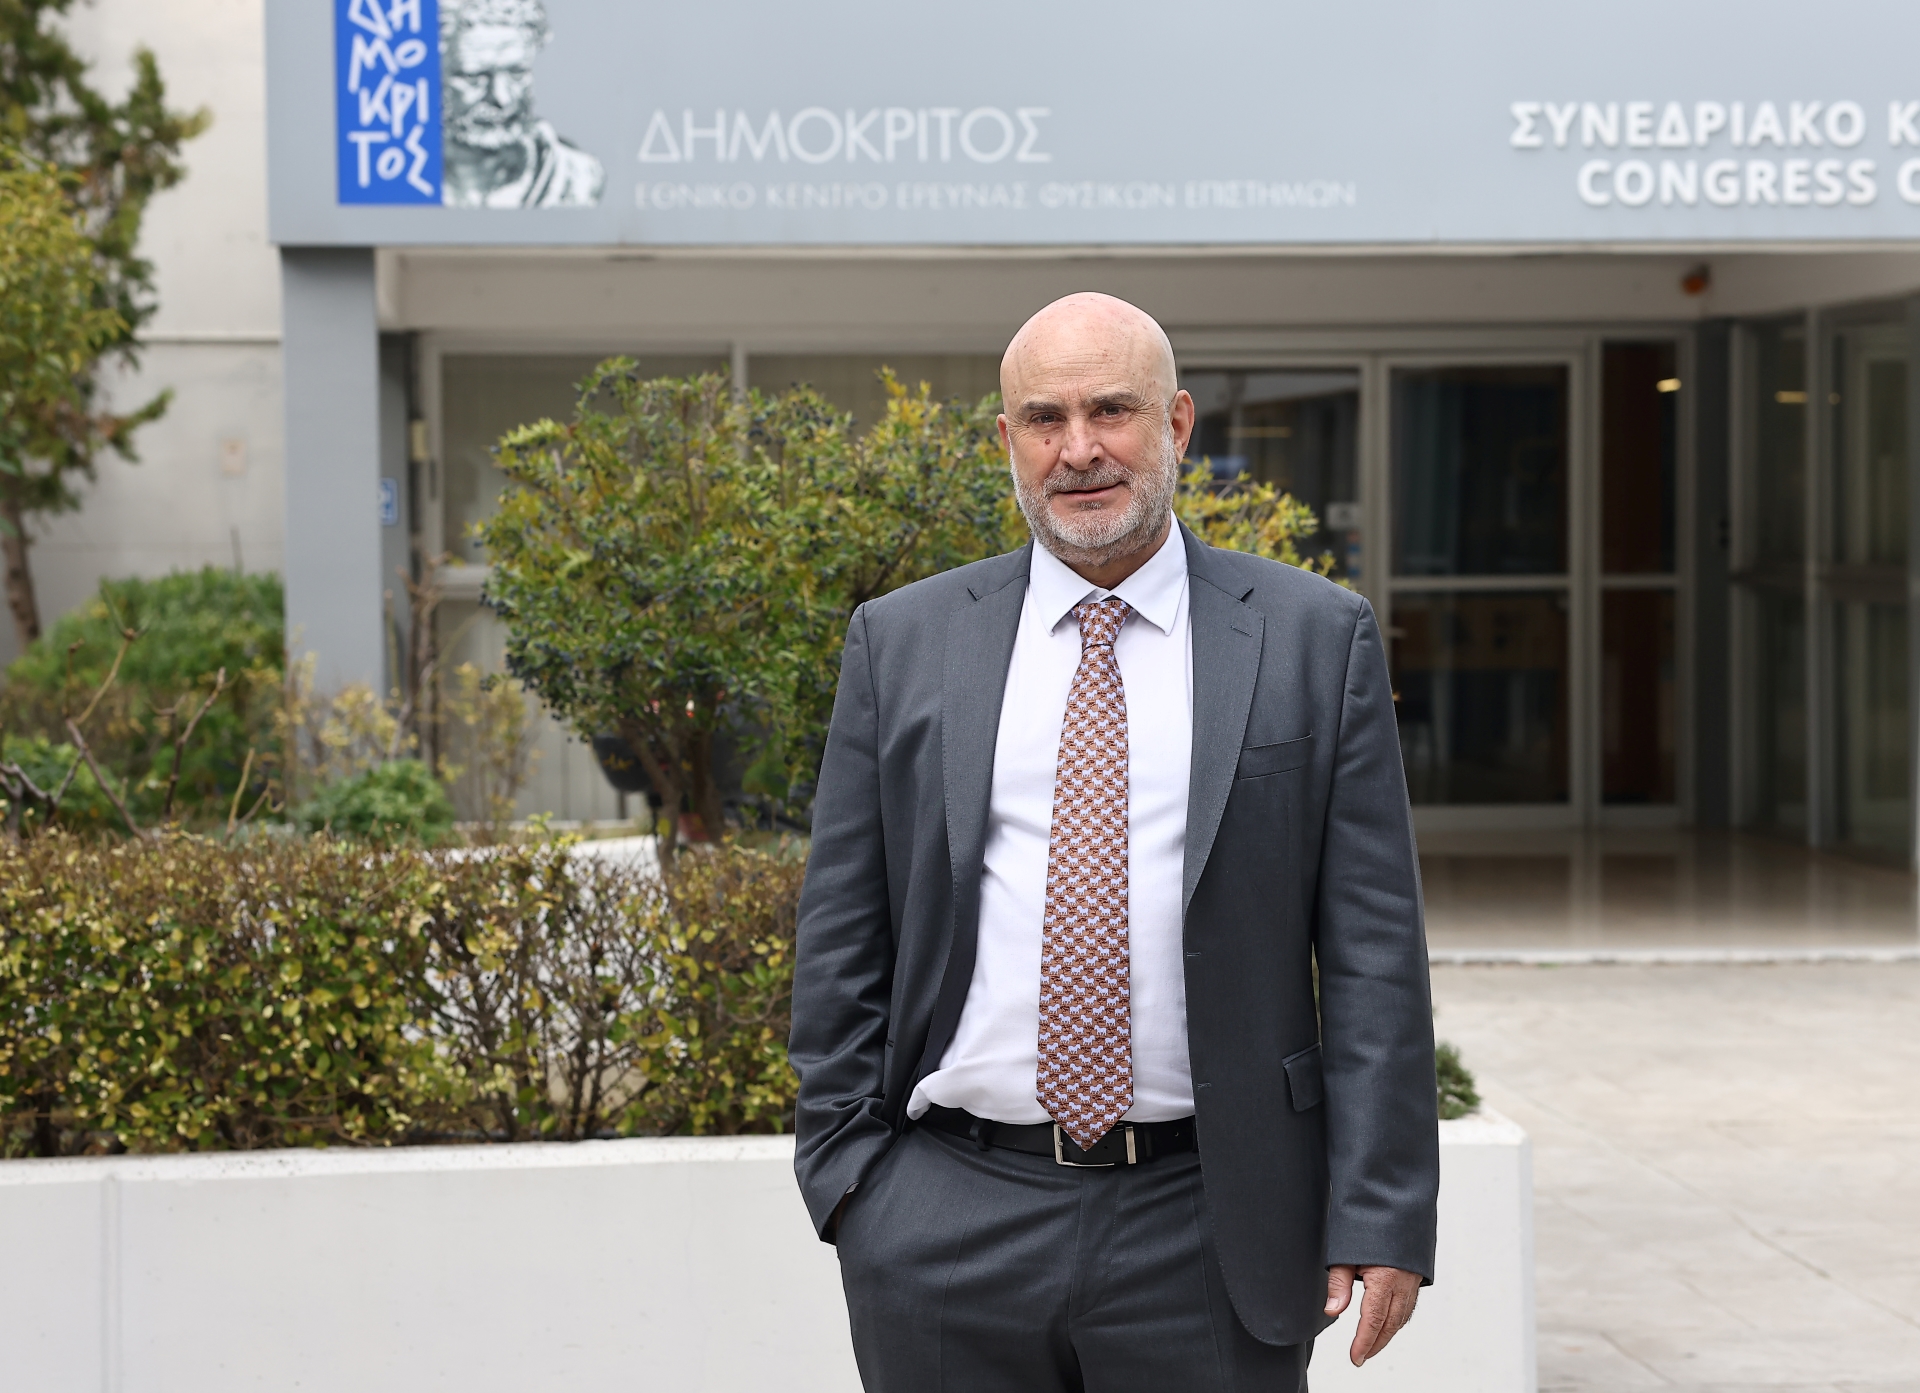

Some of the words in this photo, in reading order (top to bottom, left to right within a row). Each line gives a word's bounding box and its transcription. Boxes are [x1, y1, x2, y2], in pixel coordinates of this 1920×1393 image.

[347, 33, 427, 94] ΜΟ
[359, 74, 429, 138] ΚΡΙ
[637, 105, 1052, 164] ΔΗΜΟΚΡΙΤΟΣ
[1509, 100, 1866, 148] ΣΥΝΕΔΡΙΑΚΟ
[347, 124, 434, 197] ΤΟΣ
[1577, 158, 1878, 206] CONGRESS
[634, 180, 757, 210] ΕΘΝΙΚΟ
[765, 180, 889, 210] ΚΕΝΤΡΟ
[895, 180, 1030, 210] ΕΡΕΥΝΑΣ
[1037, 180, 1176, 209] ΦΥΣΙΚΩΝ
[1184, 179, 1357, 208] ΕΠΙΣΤΗΜΩΝ
